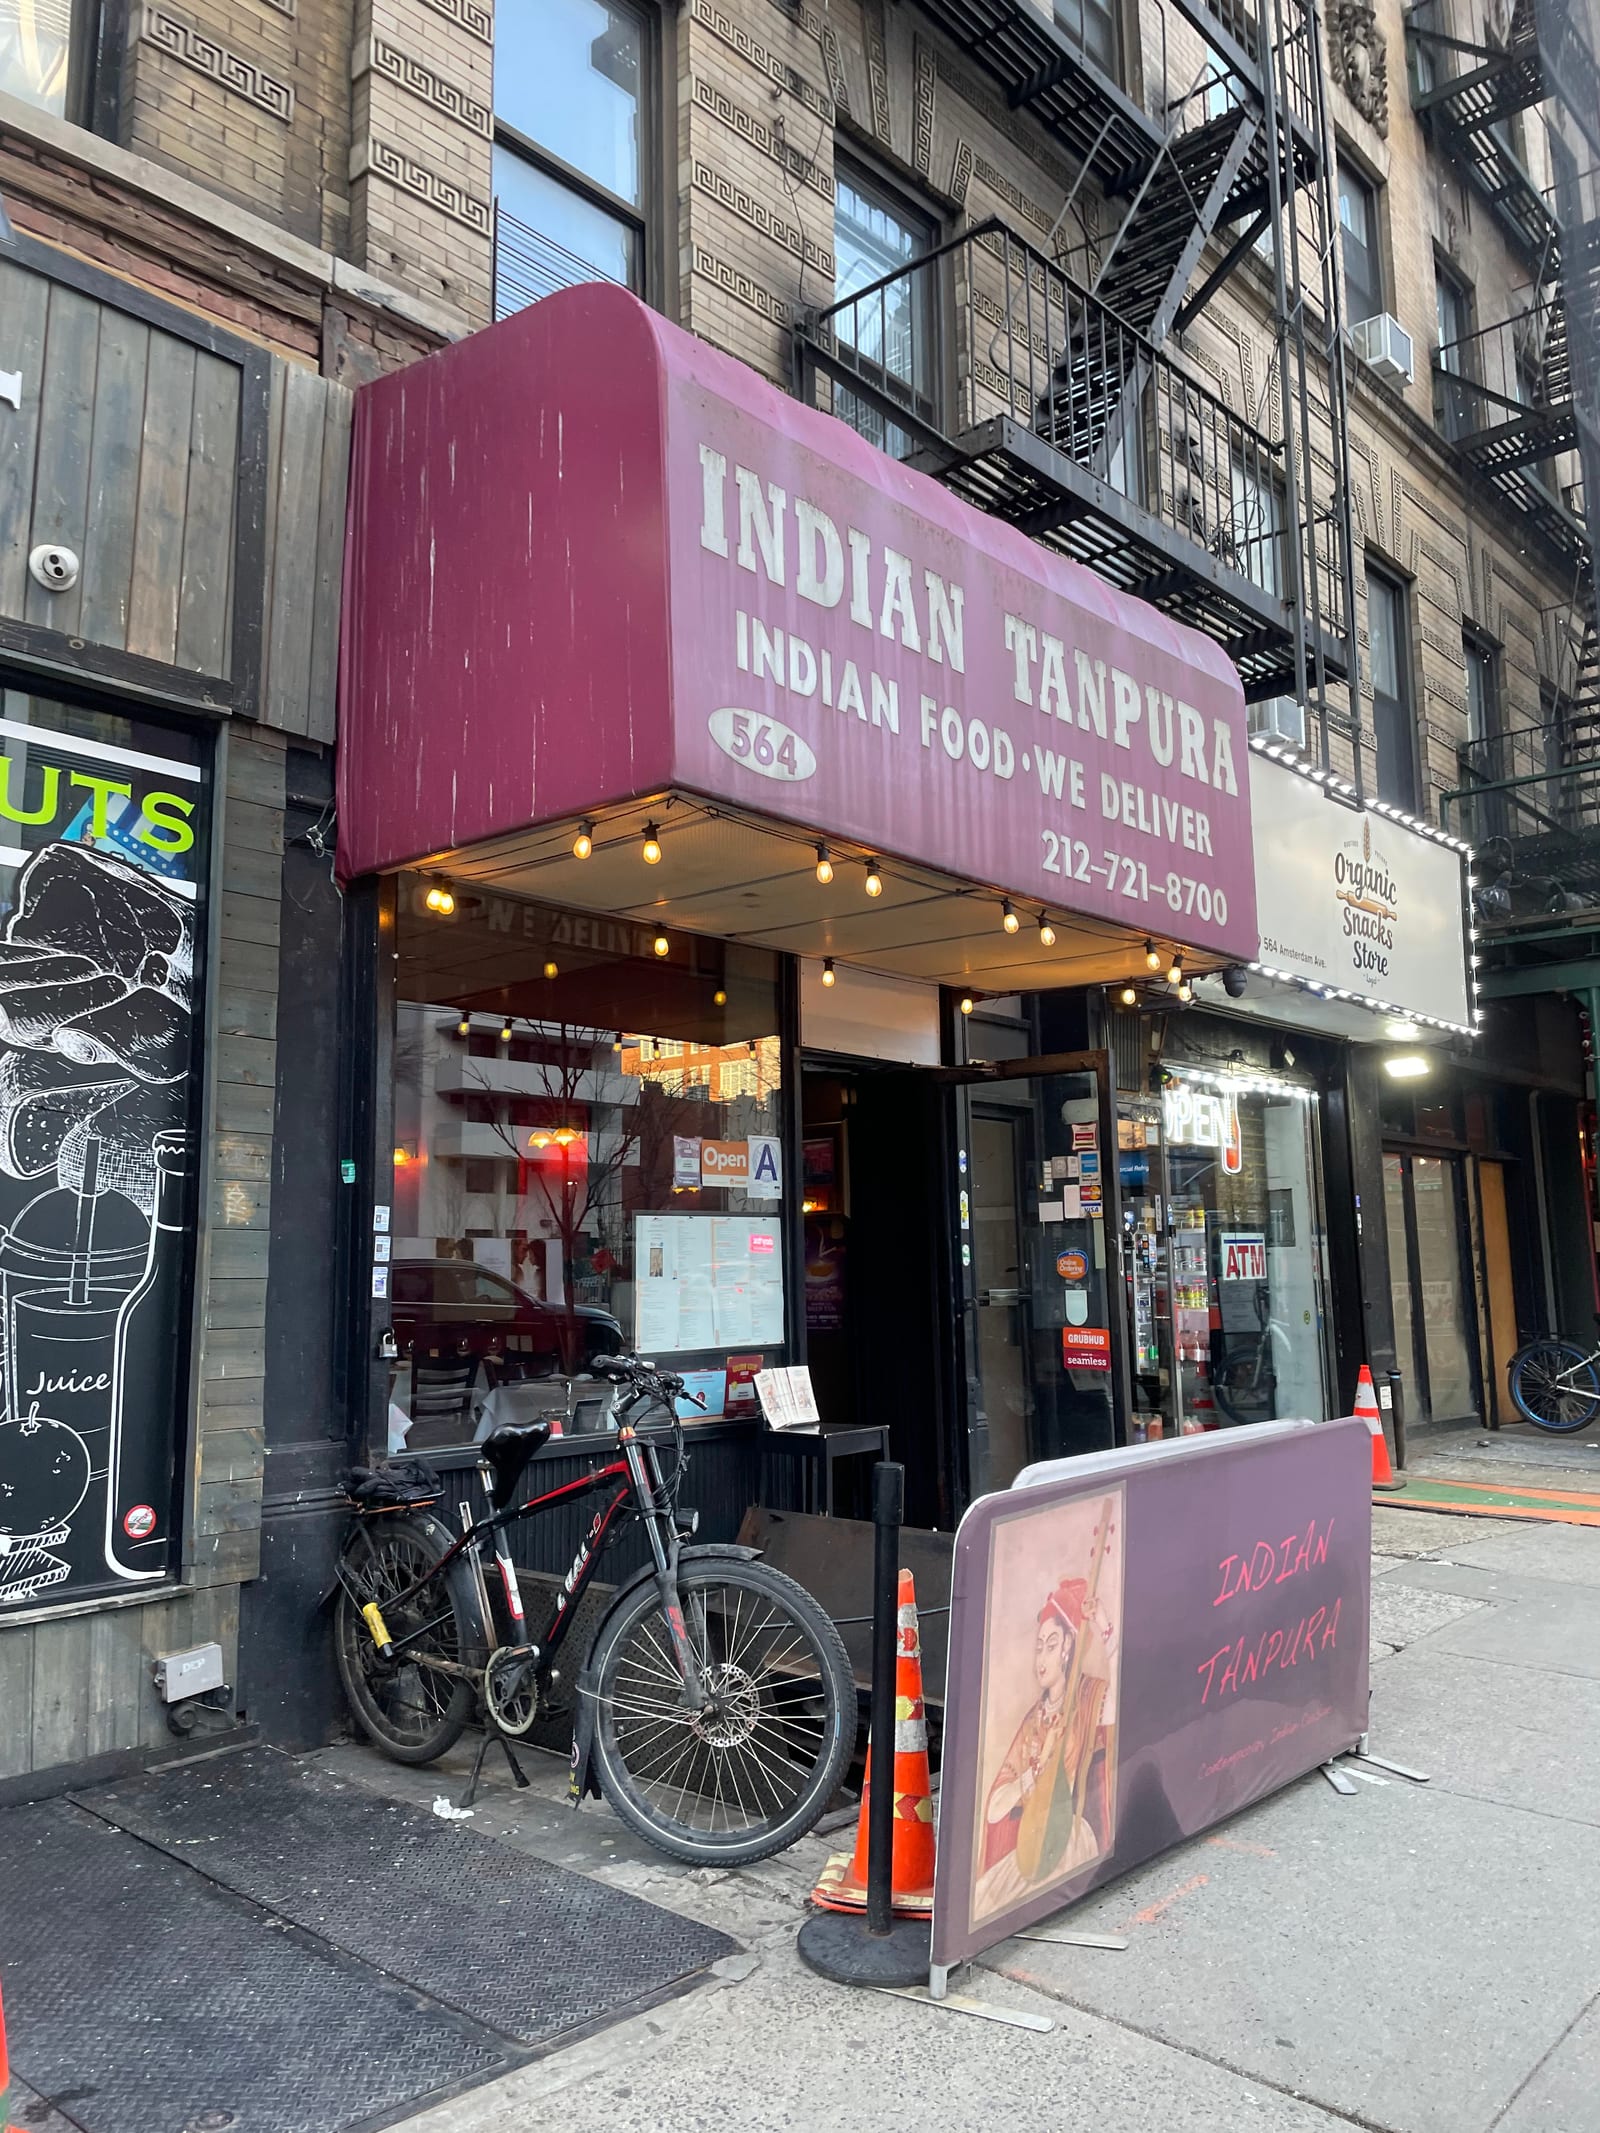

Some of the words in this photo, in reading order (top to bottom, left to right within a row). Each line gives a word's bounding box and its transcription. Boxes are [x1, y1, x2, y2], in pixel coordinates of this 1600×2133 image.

[699, 443, 965, 674] INDIAN
[1004, 612, 1239, 797] TANPURA
[730, 712, 798, 776] 564
[736, 609, 899, 735] INDIAN
[1101, 772, 1213, 857] DELIVER
[1041, 829, 1227, 927] 212-721-8700
[1335, 852, 1397, 905] Organic
[1343, 906, 1393, 950] Snacks
[1264, 936, 1278, 953] 564
[1279, 944, 1313, 965] Amsterdam
[1314, 955, 1327, 968] Ave.
[1353, 940, 1389, 976] Store
[703, 1146, 747, 1171] Open
[755, 1144, 778, 1181] A
[1226, 1245, 1265, 1278] ATM
[1067, 1333, 1105, 1345] GRUBHUB
[1067, 1356, 1107, 1366] seamless
[26, 1368, 111, 1395] Juice
[1213, 1517, 1335, 1607] INDIAN
[1198, 1597, 1342, 1704] TANPURA
